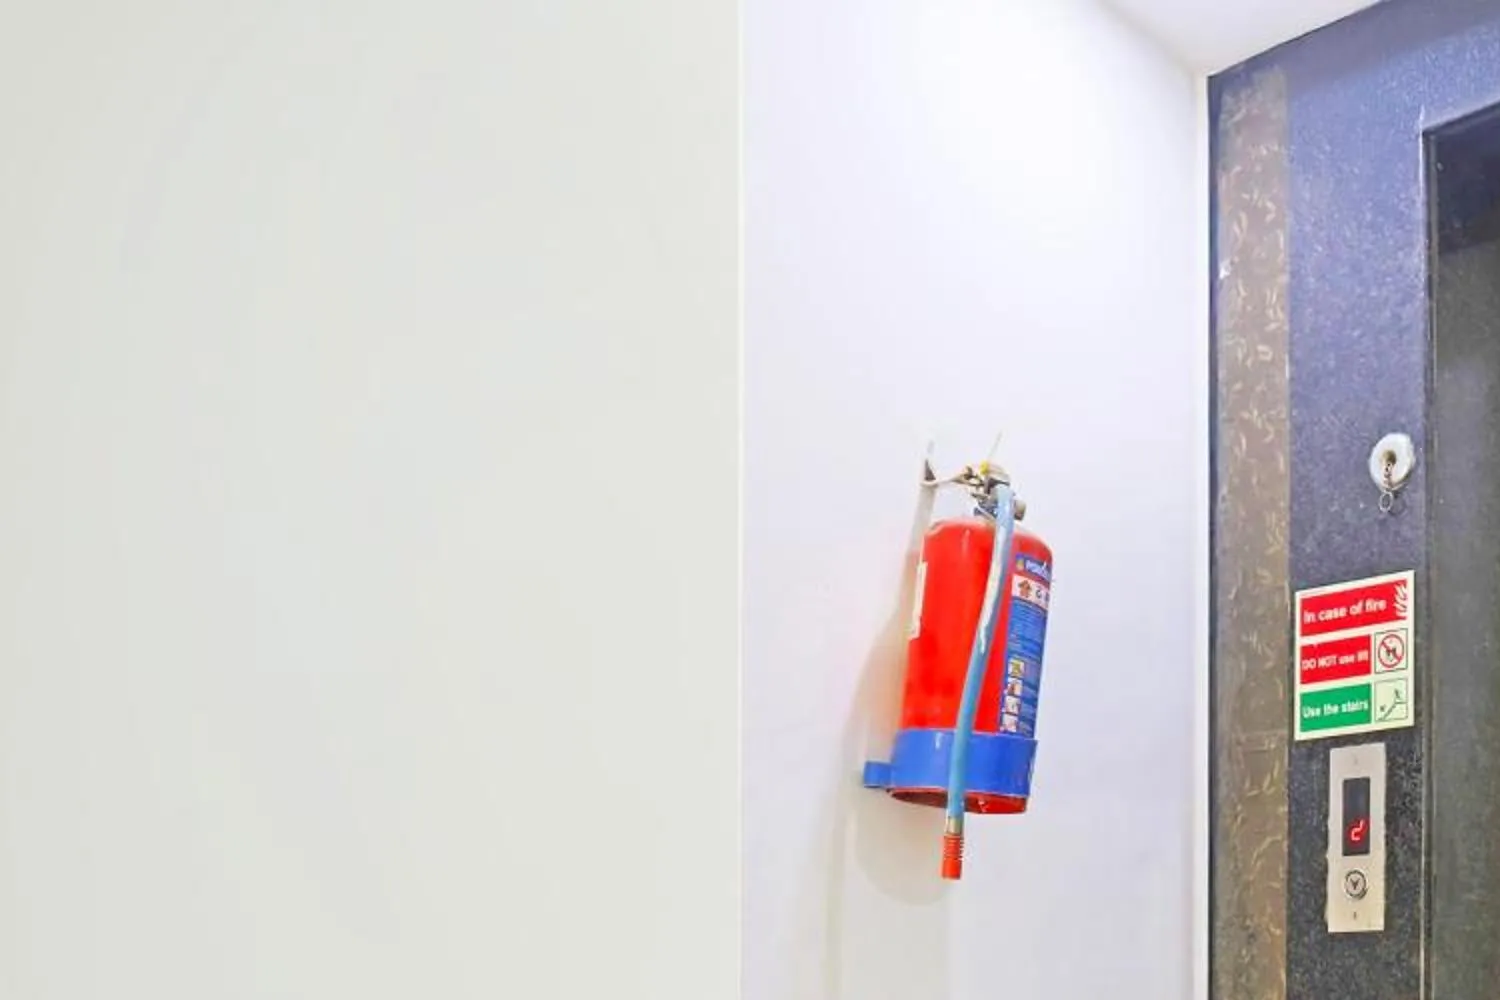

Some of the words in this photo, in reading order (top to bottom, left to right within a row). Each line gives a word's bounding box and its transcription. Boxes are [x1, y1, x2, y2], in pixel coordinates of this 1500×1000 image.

[1303, 610, 1316, 624] In
[1318, 607, 1347, 621] case
[1349, 600, 1363, 616] of
[1365, 598, 1387, 613] fire
[1302, 658, 1316, 671] DO
[1317, 654, 1337, 668] NOT
[1339, 654, 1355, 665] use
[1302, 706, 1321, 719] Use
[1323, 703, 1339, 716] the
[1341, 700, 1369, 713] stairs
